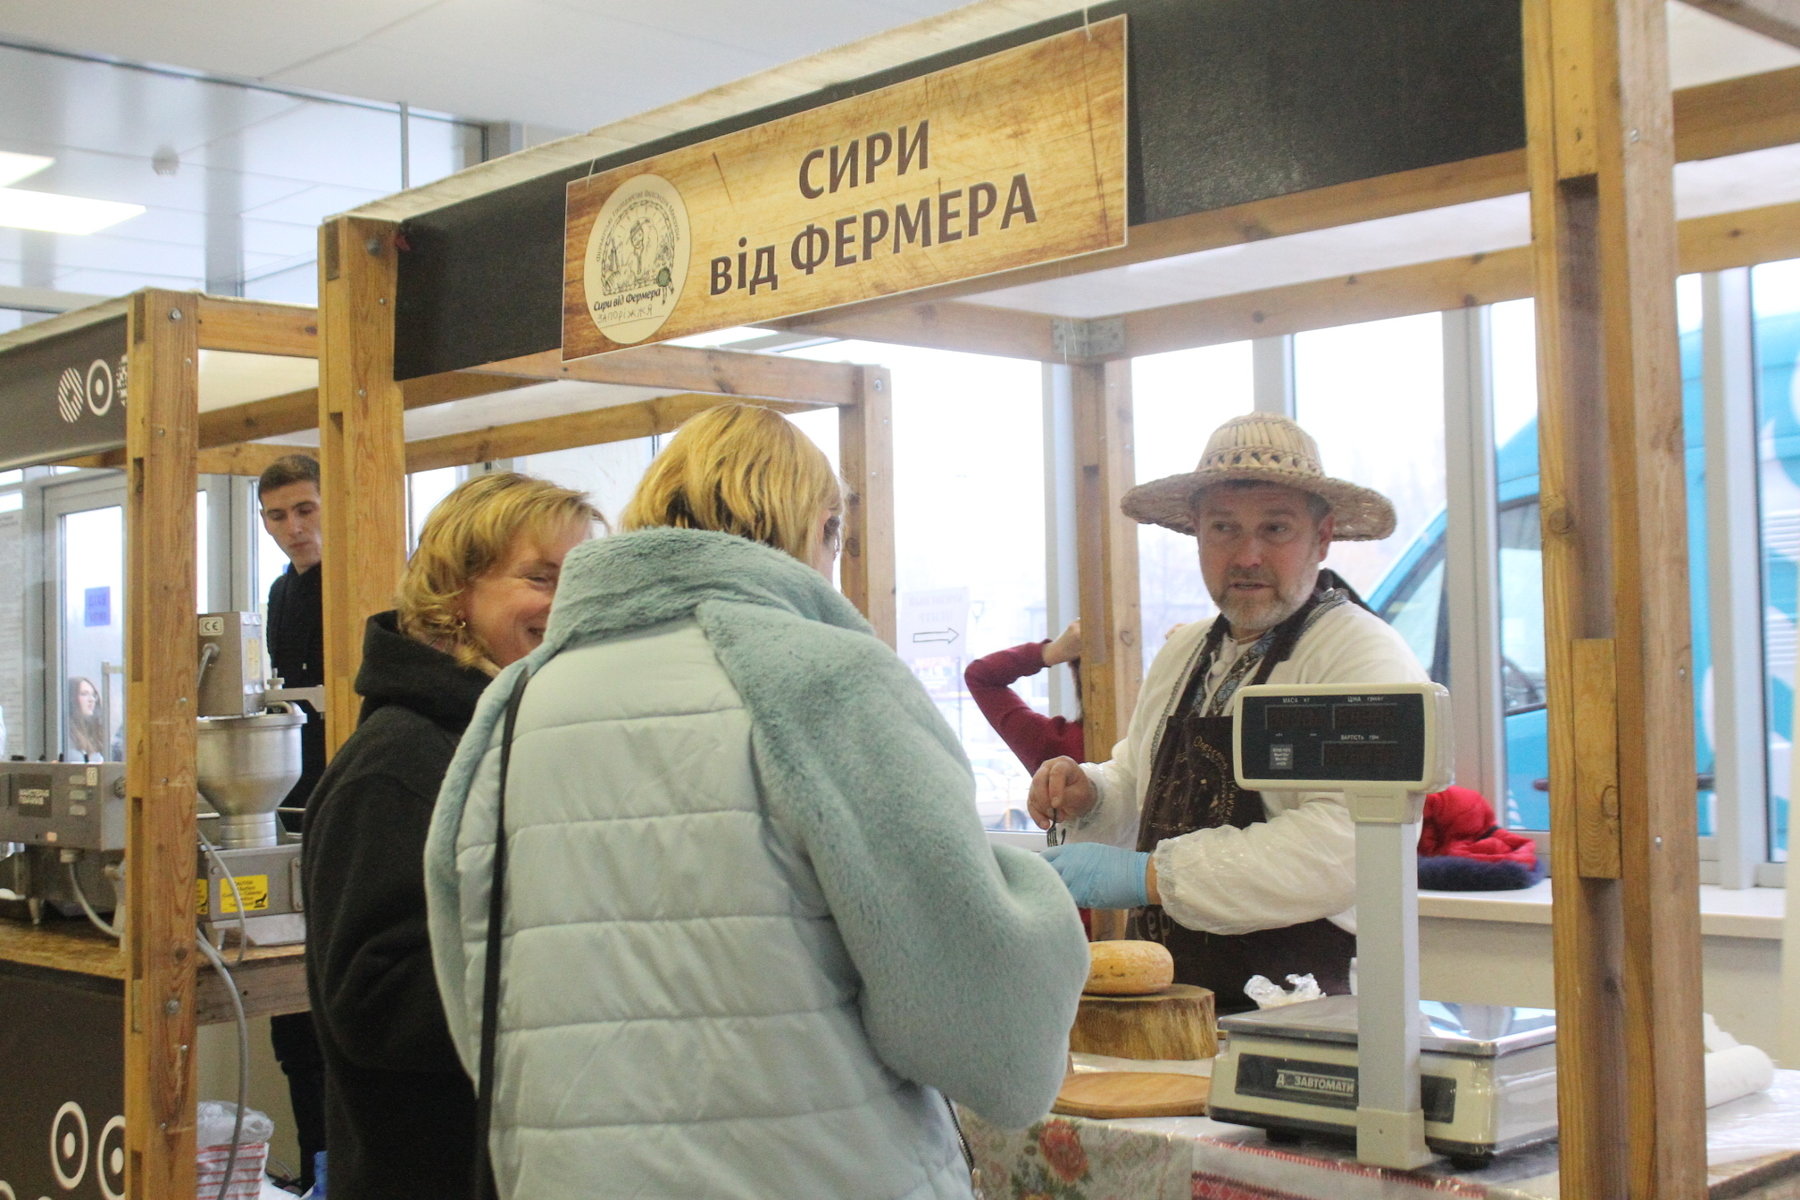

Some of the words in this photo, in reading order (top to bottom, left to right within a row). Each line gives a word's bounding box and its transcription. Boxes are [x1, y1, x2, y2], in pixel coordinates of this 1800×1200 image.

[798, 120, 931, 200] СИРИ
[710, 237, 779, 297] від
[790, 173, 1038, 275] ФЕРМЕРА
[593, 298, 612, 312] Сири
[613, 294, 624, 307] від
[626, 288, 661, 304] Фермера
[1275, 1073, 1354, 1093] ДЗАВТОМАТИ
